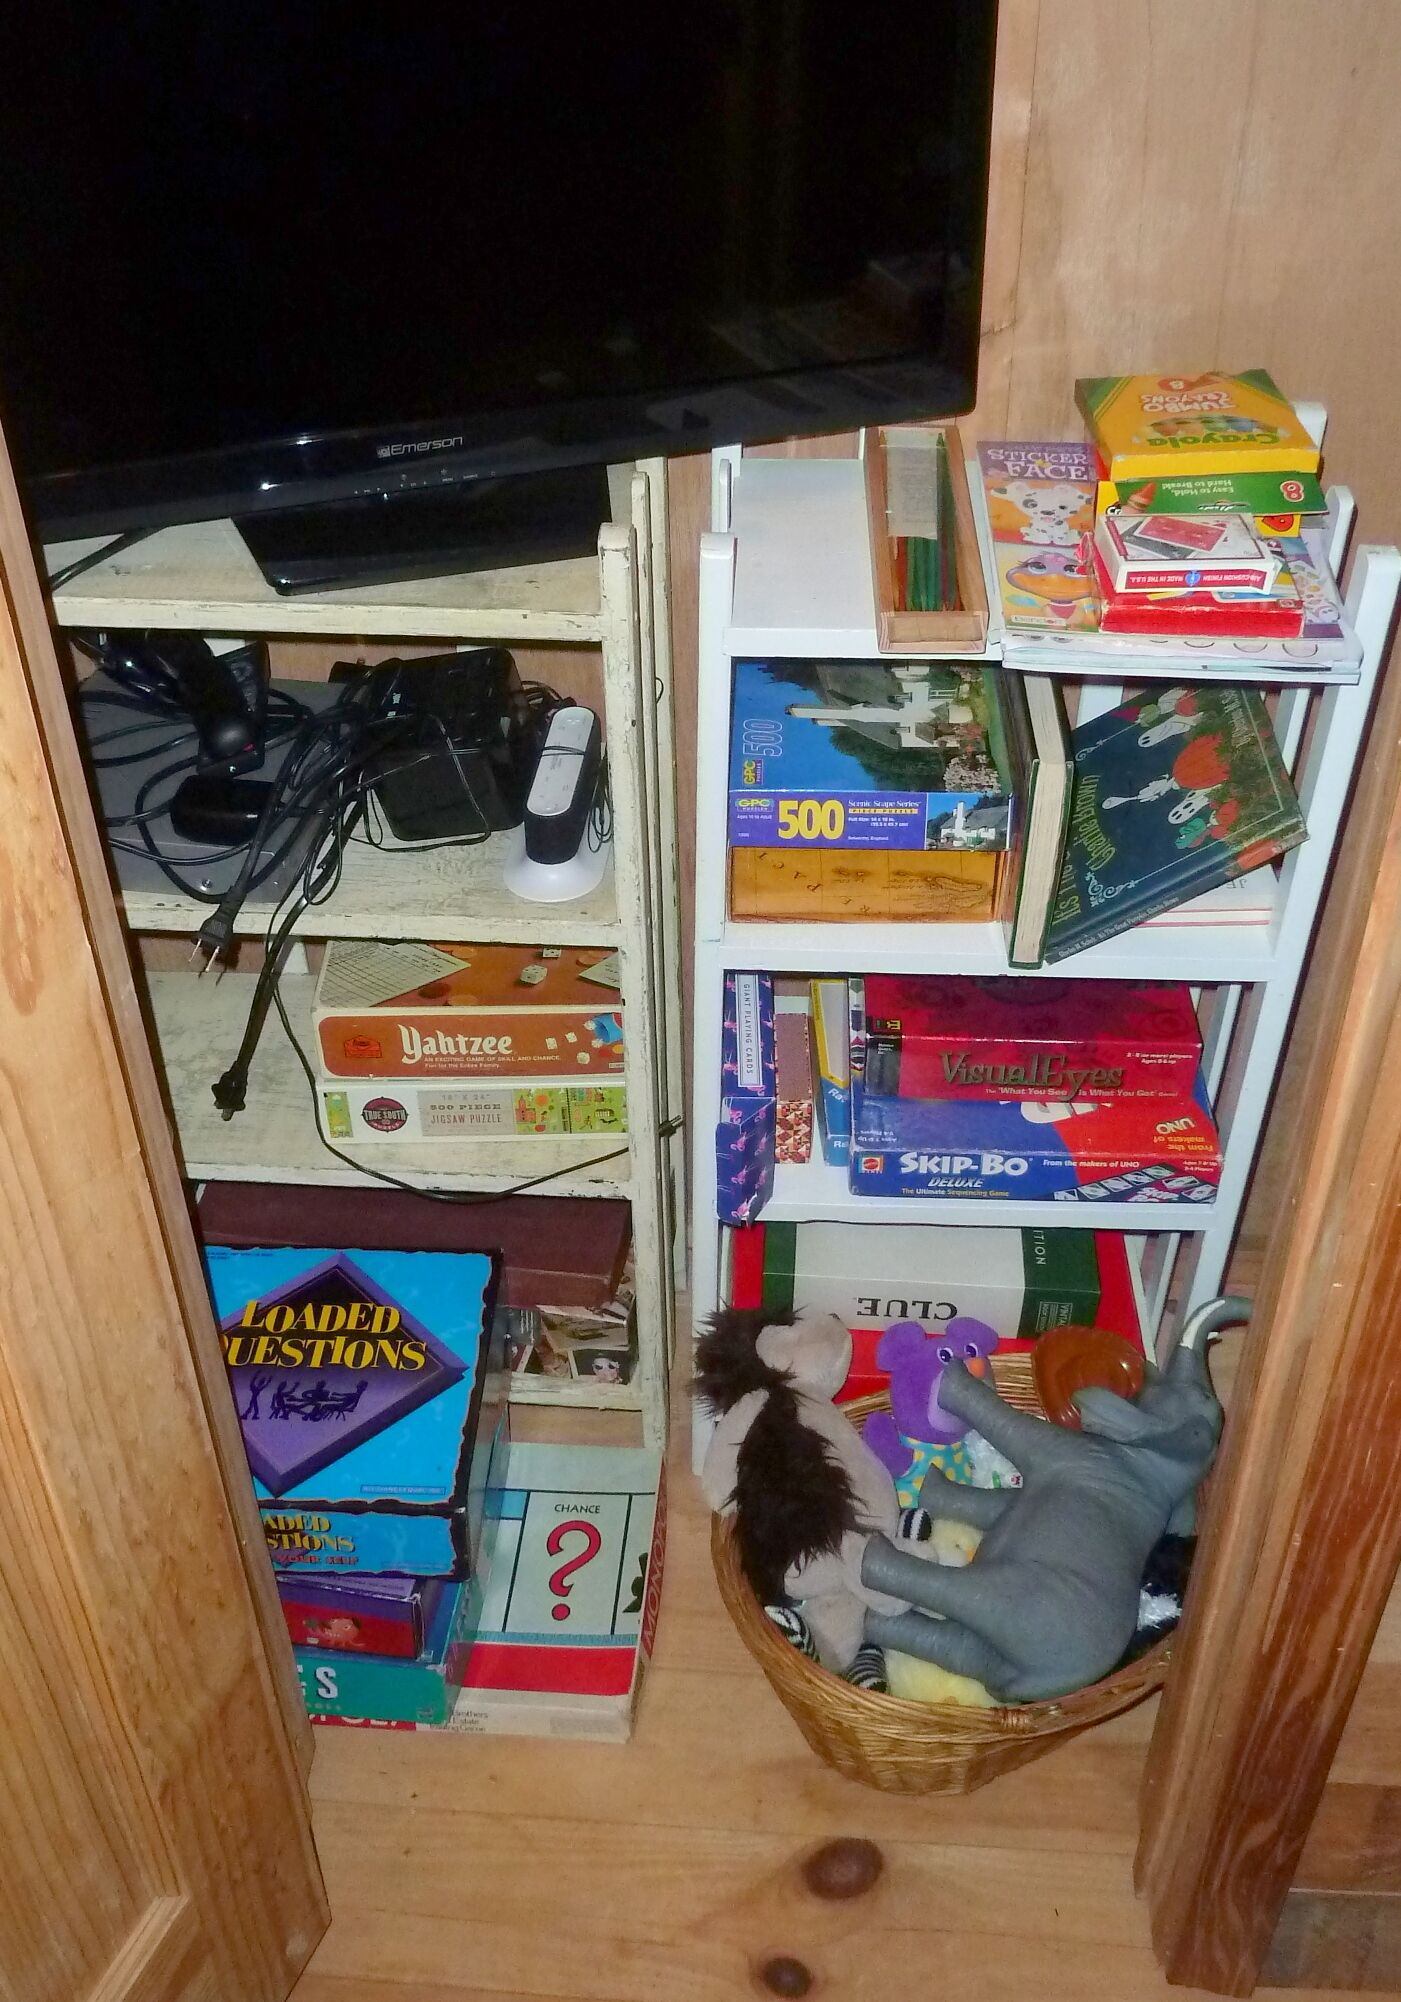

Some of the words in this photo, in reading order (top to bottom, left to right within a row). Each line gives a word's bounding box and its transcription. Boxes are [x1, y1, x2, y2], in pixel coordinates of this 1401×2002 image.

[1142, 402, 1236, 413] JUMBO
[390, 436, 463, 455] Emerson
[1146, 432, 1281, 449] Crayola
[987, 448, 1089, 465] STICKER
[1003, 461, 1088, 480] FACE
[1207, 479, 1232, 487] Hard
[1212, 486, 1234, 494] Easy
[1280, 480, 1304, 502] 8
[1202, 574, 1223, 582] FINISH
[742, 718, 783, 756] 500
[743, 759, 756, 785] GPC
[738, 799, 771, 807] GPC
[848, 799, 871, 807] Scenic
[873, 800, 896, 808] Scape
[896, 799, 919, 808] Series
[1071, 774, 1101, 825] Brown
[777, 799, 846, 840] 500
[1073, 817, 1116, 872] Charlie
[743, 983, 751, 1007] GIANT
[744, 1010, 753, 1044] PLAYING
[397, 1023, 513, 1065] Yahtzee
[745, 1047, 754, 1074] CARDS
[939, 1050, 1125, 1101] VisualEyes
[1028, 1087, 1046, 1095] You
[1047, 1088, 1068, 1096] See
[1089, 1089, 1116, 1097] What
[1117, 1089, 1135, 1097] You
[363, 1110, 382, 1120] TRUE
[381, 1109, 407, 1121] SOUTH
[430, 1114, 466, 1124] JIGSAW
[469, 1113, 502, 1123] PUZZLE
[1154, 1117, 1196, 1135] UNO
[1153, 1136, 1166, 1144] of
[1167, 1143, 1184, 1151] the
[1186, 1144, 1214, 1152] From
[900, 1151, 1028, 1176] SKIP-BO
[1043, 1159, 1063, 1167] From
[1079, 1160, 1108, 1168] makers
[1109, 1160, 1119, 1168] of
[927, 1176, 985, 1188] DELUXE
[901, 1187, 915, 1195] The
[915, 1187, 946, 1195] Ultimate
[947, 1189, 988, 1197] Sequencing
[1032, 1229, 1047, 1265] ITION
[239, 1299, 400, 1334] LOADED
[857, 1297, 958, 1321] CLUE
[554, 1503, 601, 1515] CHANCE
[263, 1513, 331, 1532] ADED
[267, 1533, 356, 1552] STIONS
